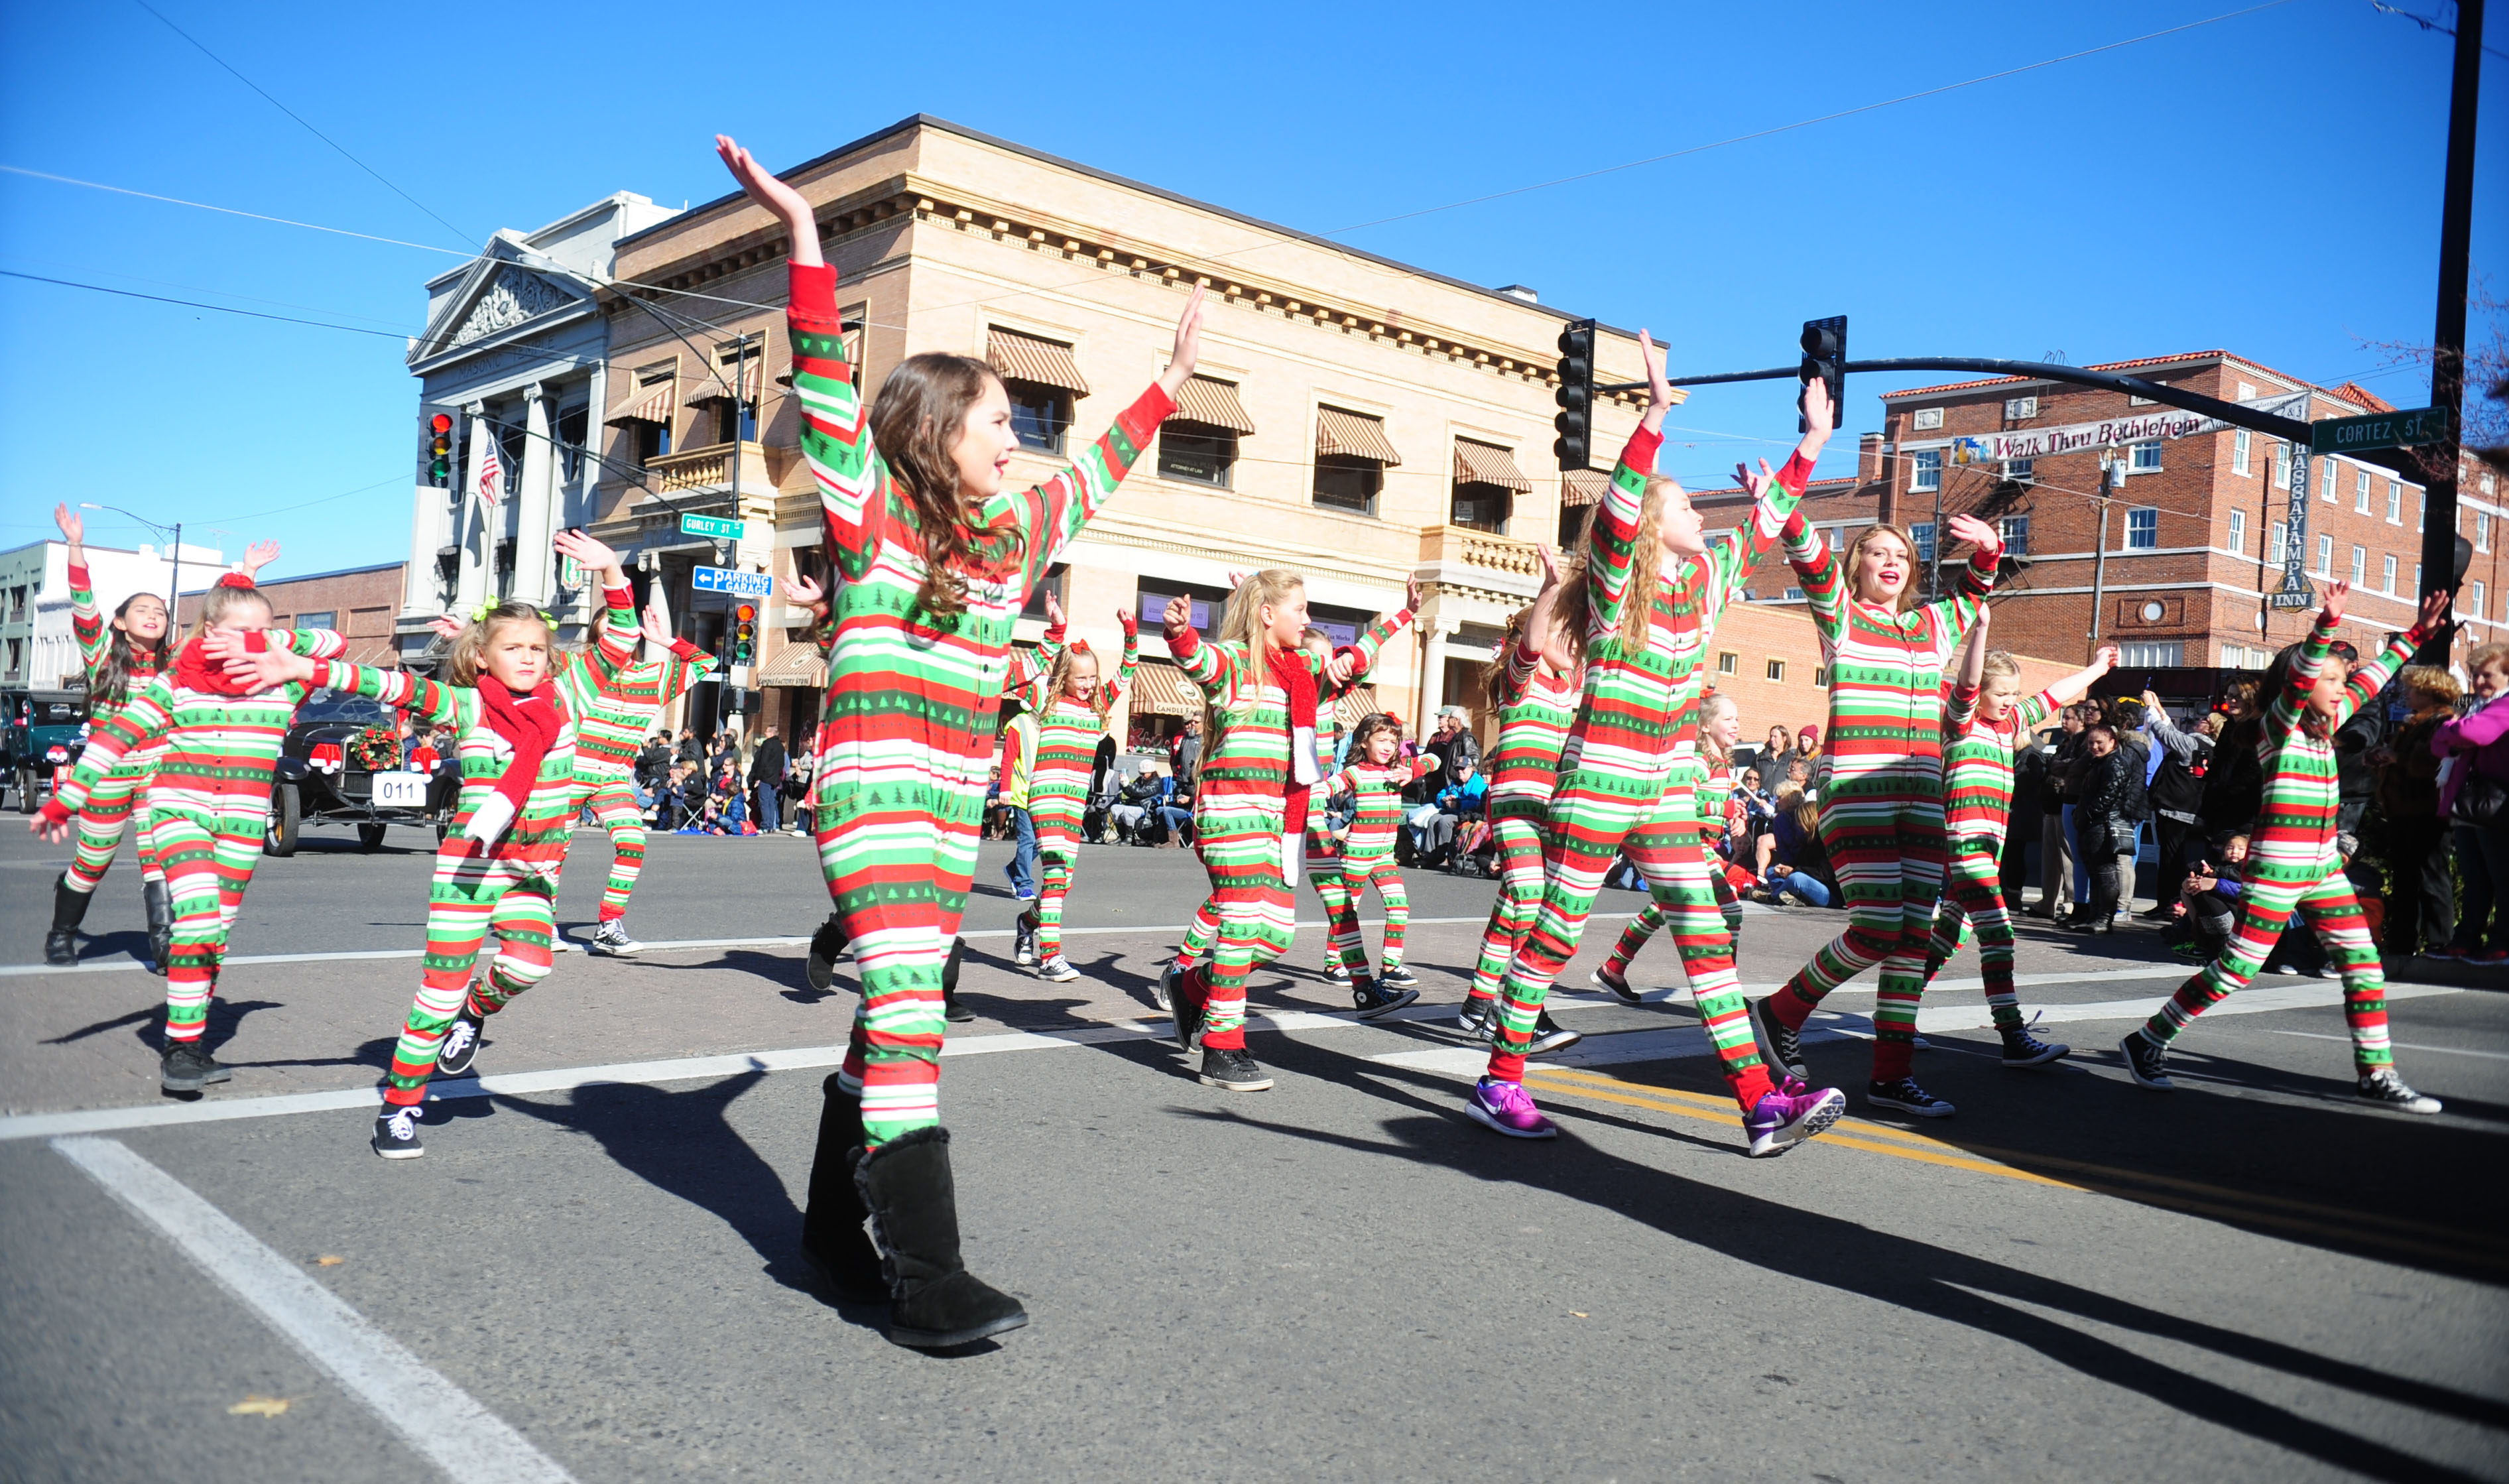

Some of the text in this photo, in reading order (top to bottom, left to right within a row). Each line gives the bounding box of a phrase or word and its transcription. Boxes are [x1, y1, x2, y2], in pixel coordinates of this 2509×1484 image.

[459, 335, 555, 378] MASONIC TEMPLE
[2296, 404, 2302, 417] 3
[1996, 433, 2043, 458] Walk
[2048, 431, 2091, 452] Thru
[2097, 416, 2199, 444] Bethlehem
[2337, 418, 2423, 444] CORTEZ ST
[2286, 442, 2307, 591] HASSAYAMPA
[686, 518, 715, 531] GURLEY
[721, 523, 730, 534] ST
[713, 570, 769, 589] PARKING
[725, 582, 768, 595] GARAGE
[2275, 593, 2308, 607] INN
[1156, 705, 1183, 714] CANDLE
[383, 782, 413, 798] 011
